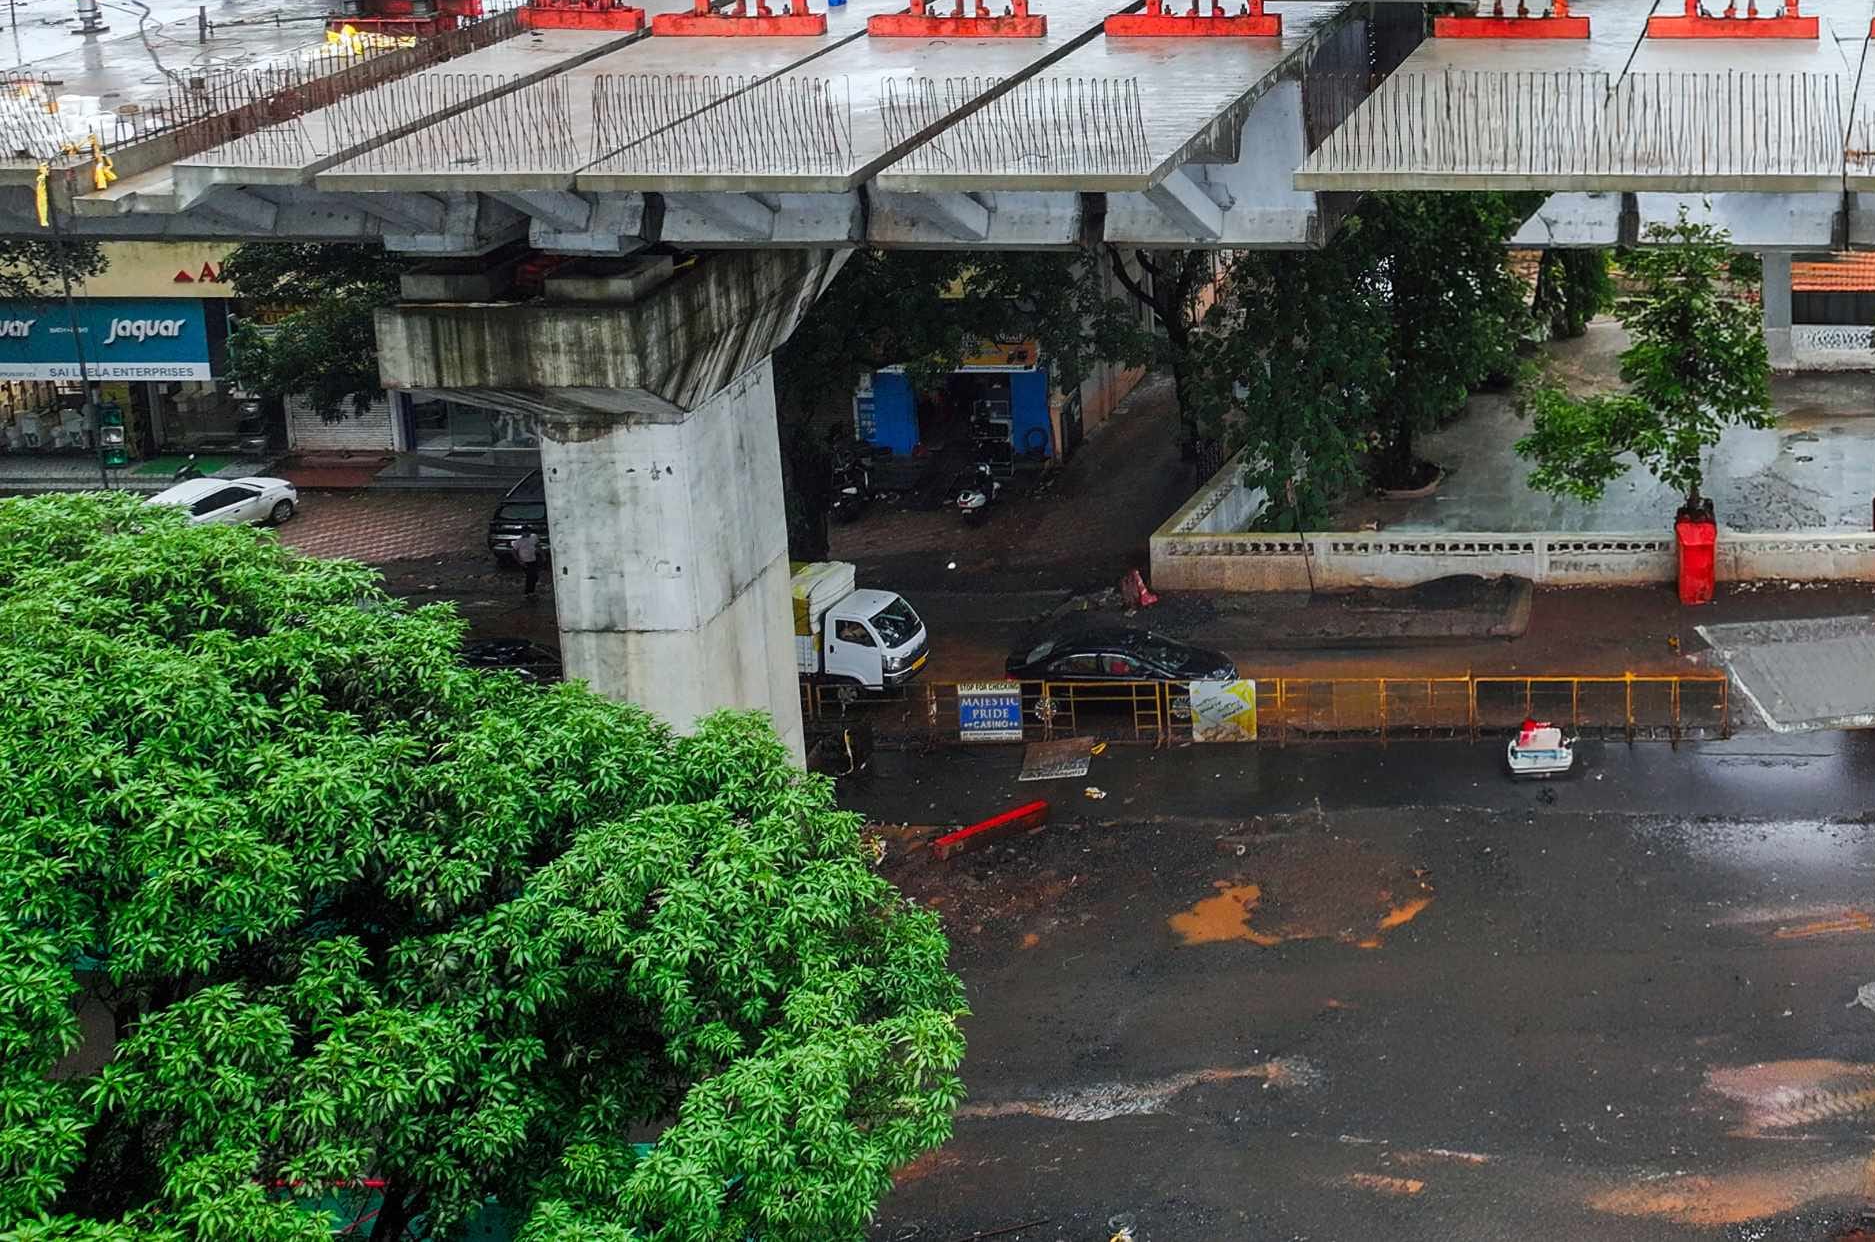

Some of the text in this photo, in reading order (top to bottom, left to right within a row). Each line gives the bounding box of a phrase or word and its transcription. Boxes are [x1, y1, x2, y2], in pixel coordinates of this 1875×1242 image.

[0, 318, 37, 338] uar
[49, 367, 69, 378] SAI
[72, 367, 110, 378] LELA
[112, 367, 194, 378] ENTERPRISES
[961, 697, 1019, 708] MAJESTIC
[972, 708, 1010, 720] PRIDE
[973, 719, 1009, 729] CASINO
